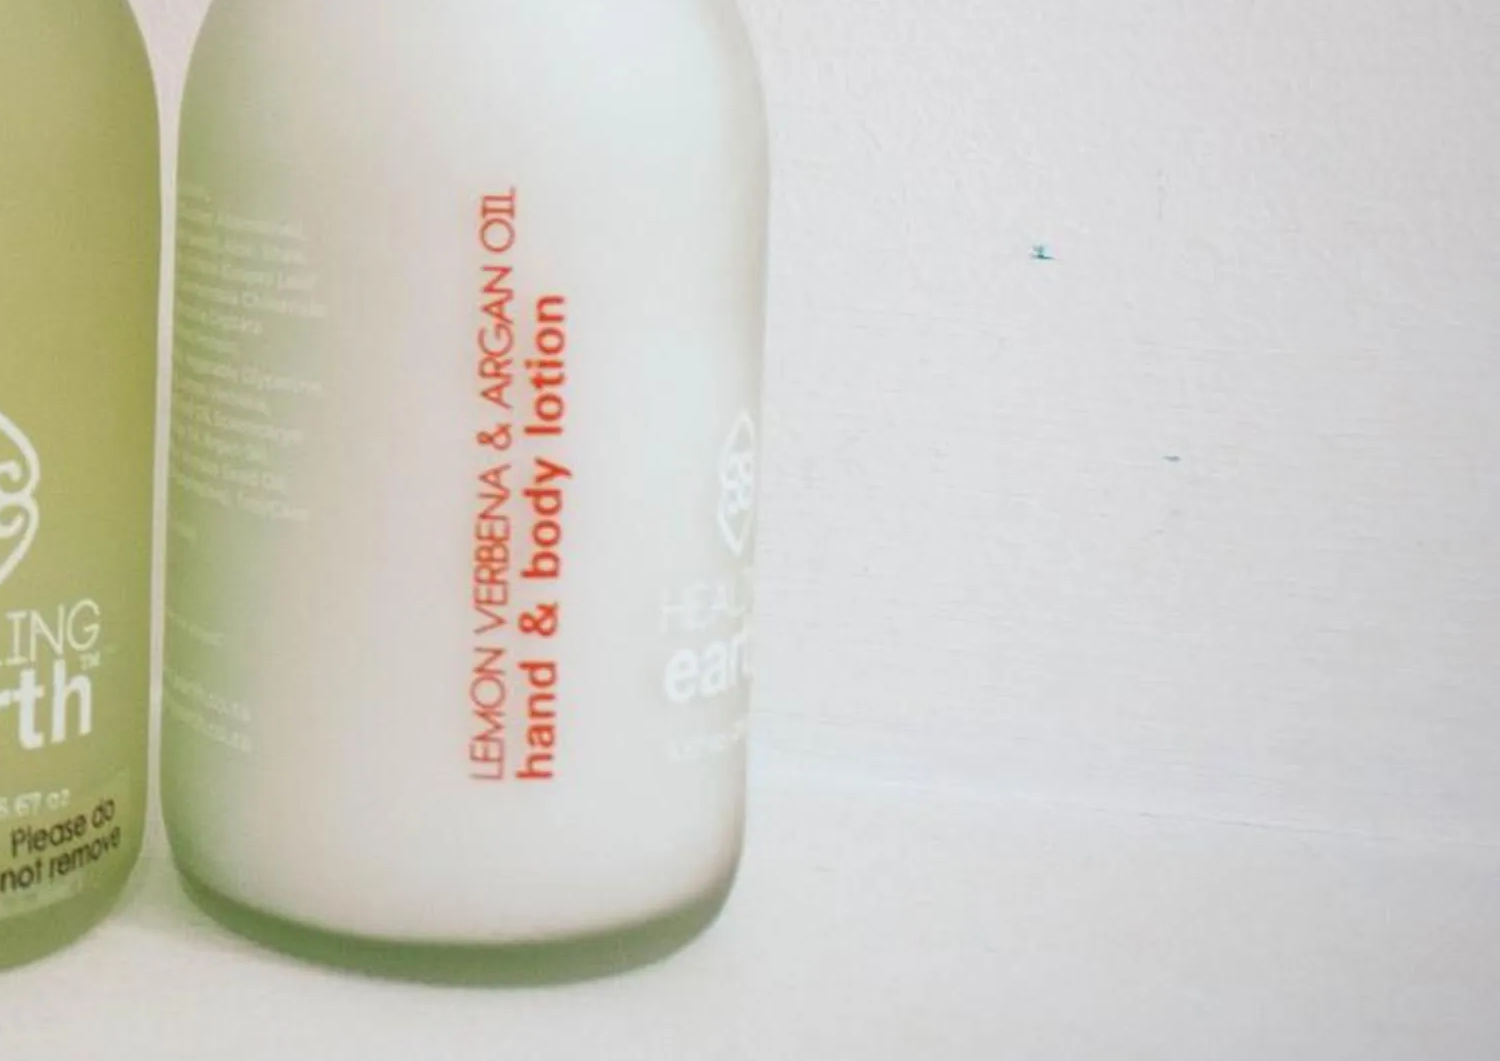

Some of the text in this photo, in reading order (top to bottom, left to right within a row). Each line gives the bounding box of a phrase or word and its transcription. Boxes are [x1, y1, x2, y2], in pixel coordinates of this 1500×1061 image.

[468, 185, 516, 782] LEMON VERBENA & ARGAN OIL
[516, 295, 572, 780] hand & body lotion
[0, 826, 122, 893] not remove
[10, 798, 116, 857] Please do
